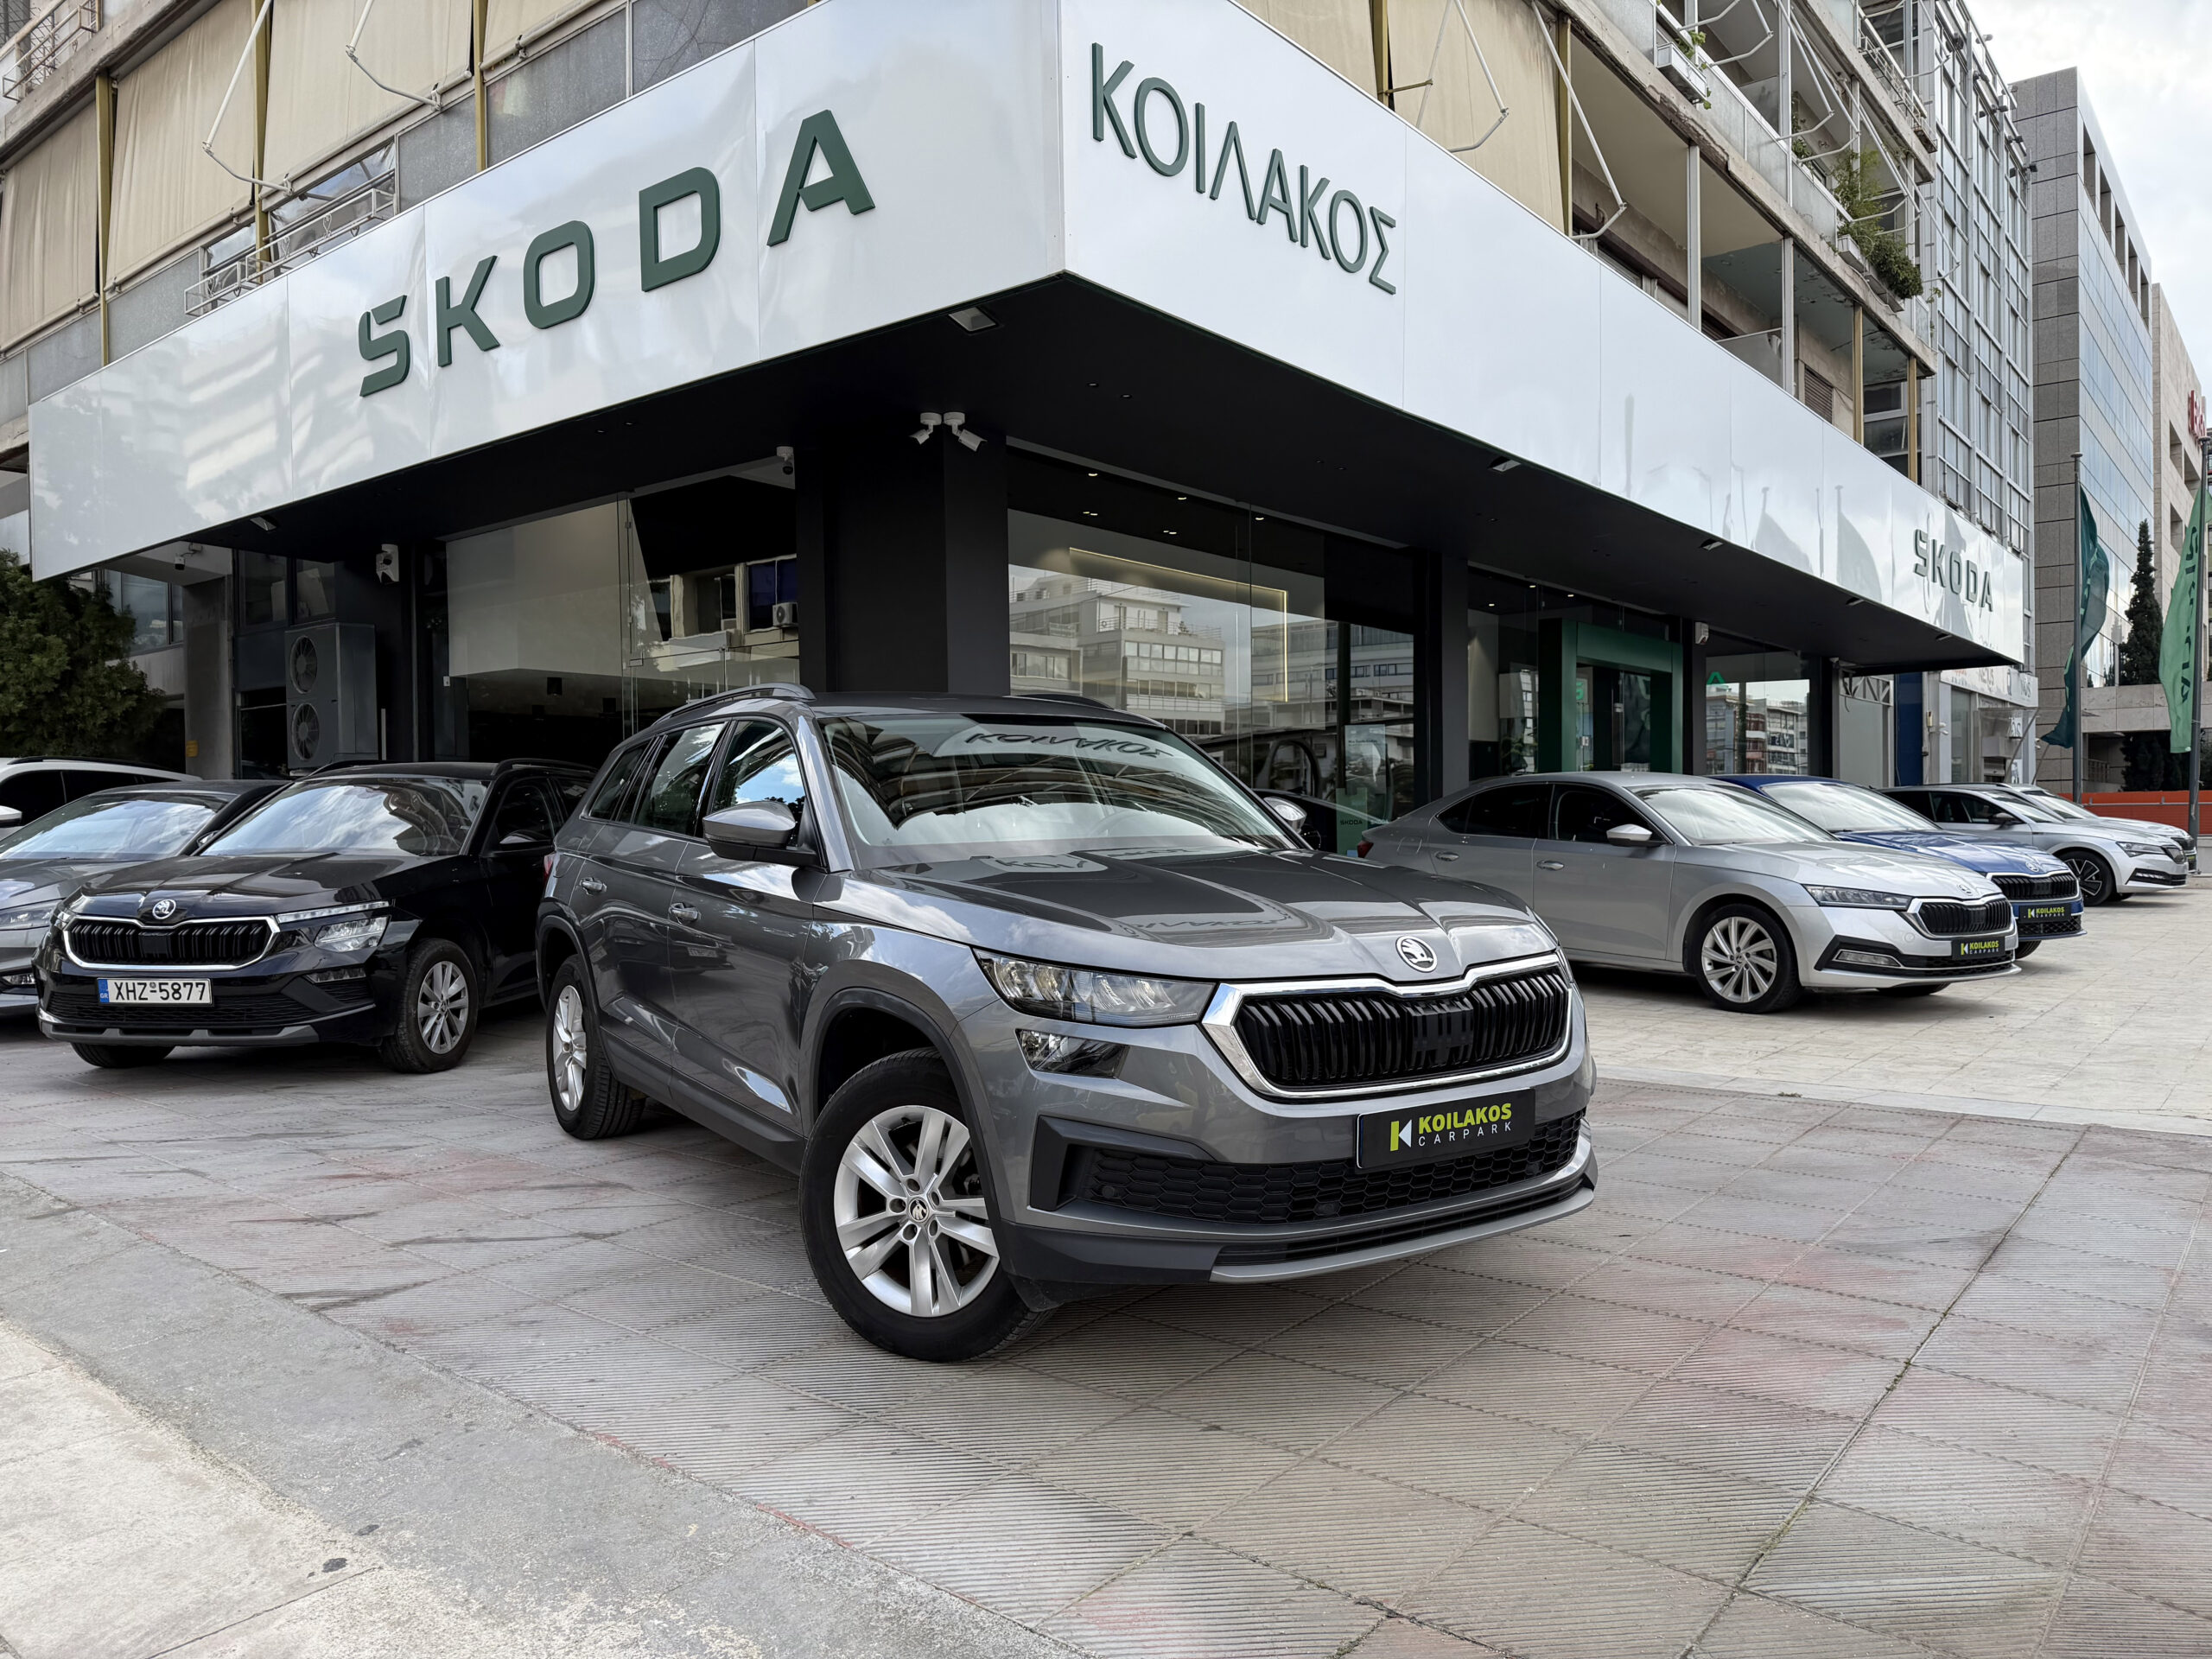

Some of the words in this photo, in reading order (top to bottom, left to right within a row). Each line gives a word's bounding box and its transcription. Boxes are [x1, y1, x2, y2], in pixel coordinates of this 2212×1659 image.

[1092, 43, 1396, 296] ΚΟΙΛΑΚΟΣ
[359, 109, 876, 397] SKODA
[1914, 529, 1993, 612] SKODA
[1969, 940, 1999, 950] KOILAKOS
[1418, 1103, 1512, 1135] KOILAKOS
[1418, 1122, 1512, 1147] CARPARK
